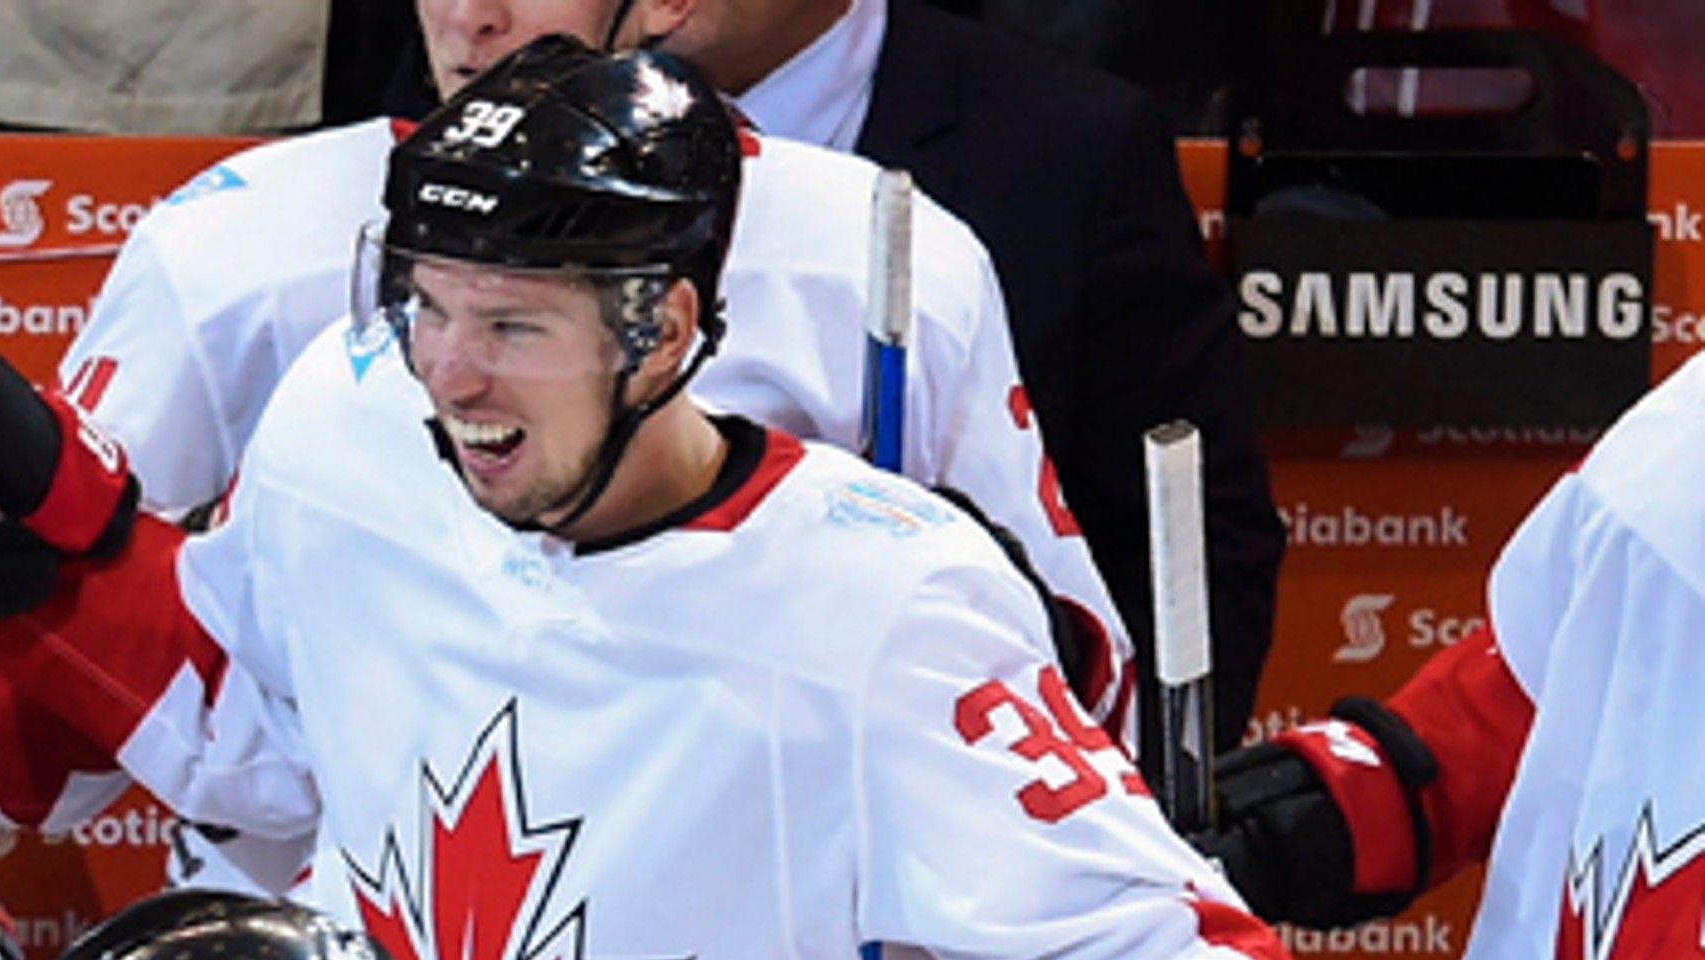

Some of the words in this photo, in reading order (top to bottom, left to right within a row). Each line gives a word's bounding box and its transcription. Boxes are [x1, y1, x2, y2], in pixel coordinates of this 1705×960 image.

[443, 101, 525, 149] 39
[417, 183, 498, 215] CCM
[1237, 271, 1644, 339] SAMSUNG
